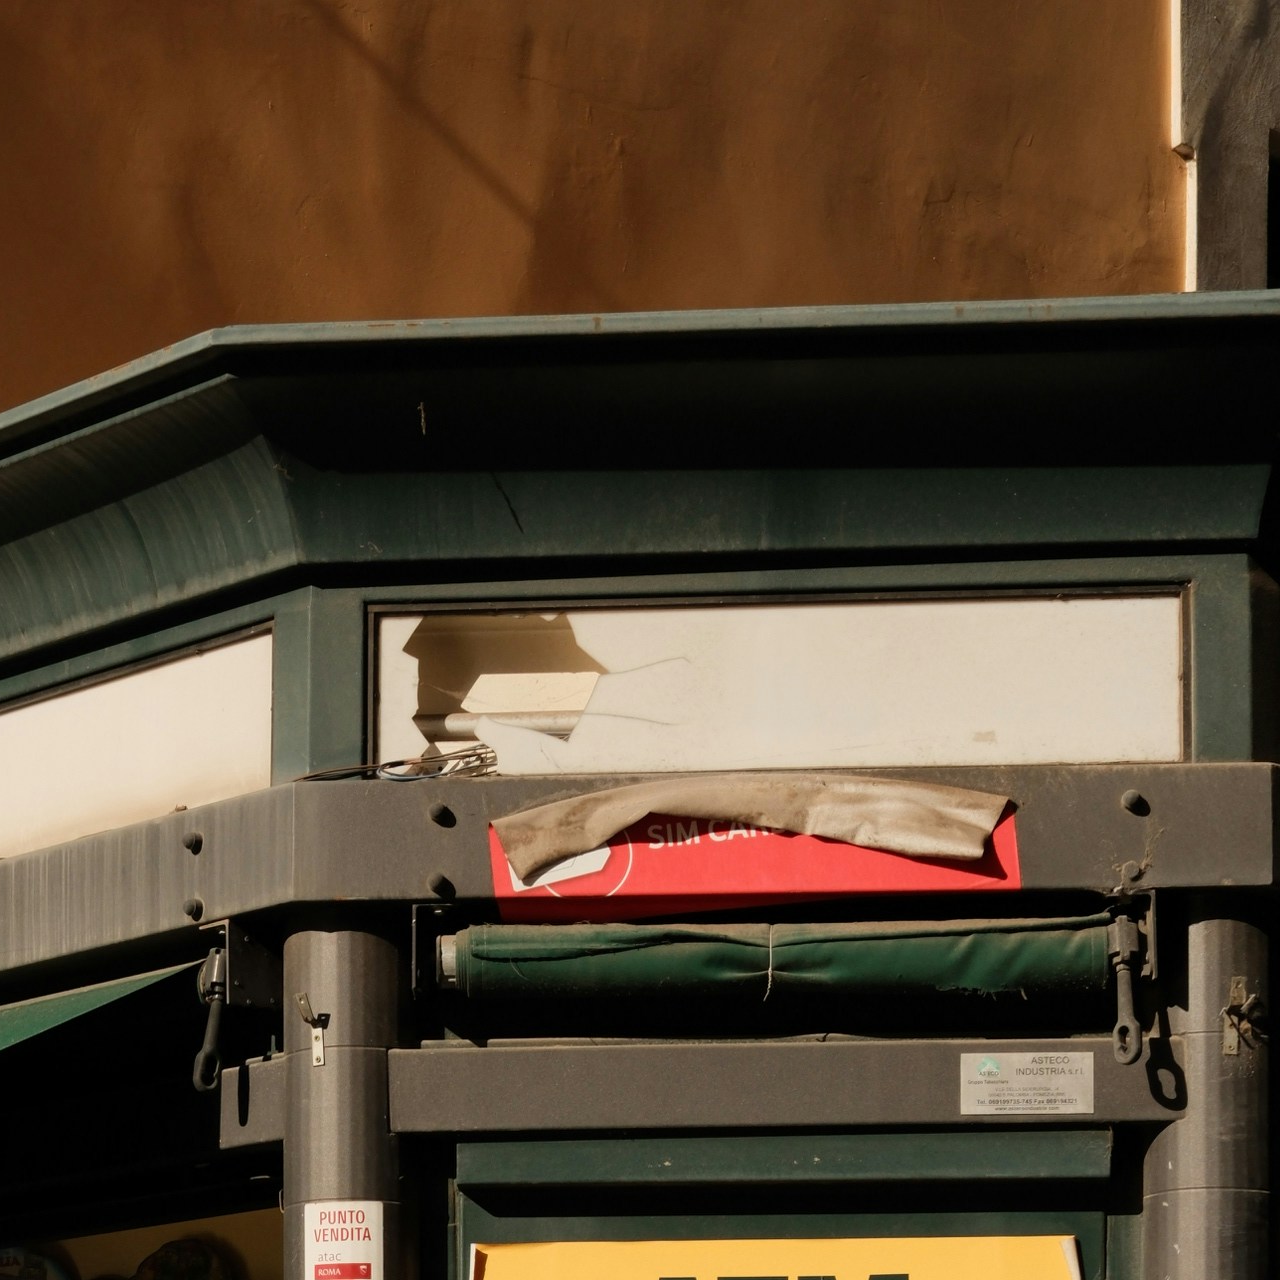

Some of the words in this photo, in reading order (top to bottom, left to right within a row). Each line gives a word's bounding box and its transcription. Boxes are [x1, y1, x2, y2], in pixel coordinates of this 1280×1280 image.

[647, 821, 701, 850] SIM
[1030, 1056, 1070, 1064] ASTECO
[1016, 1067, 1066, 1076] INDUSTRIA
[320, 1210, 365, 1226] PUNTO
[314, 1227, 372, 1242] VENDITA
[318, 1252, 341, 1262] atac
[318, 1268, 341, 1276] ROMA
